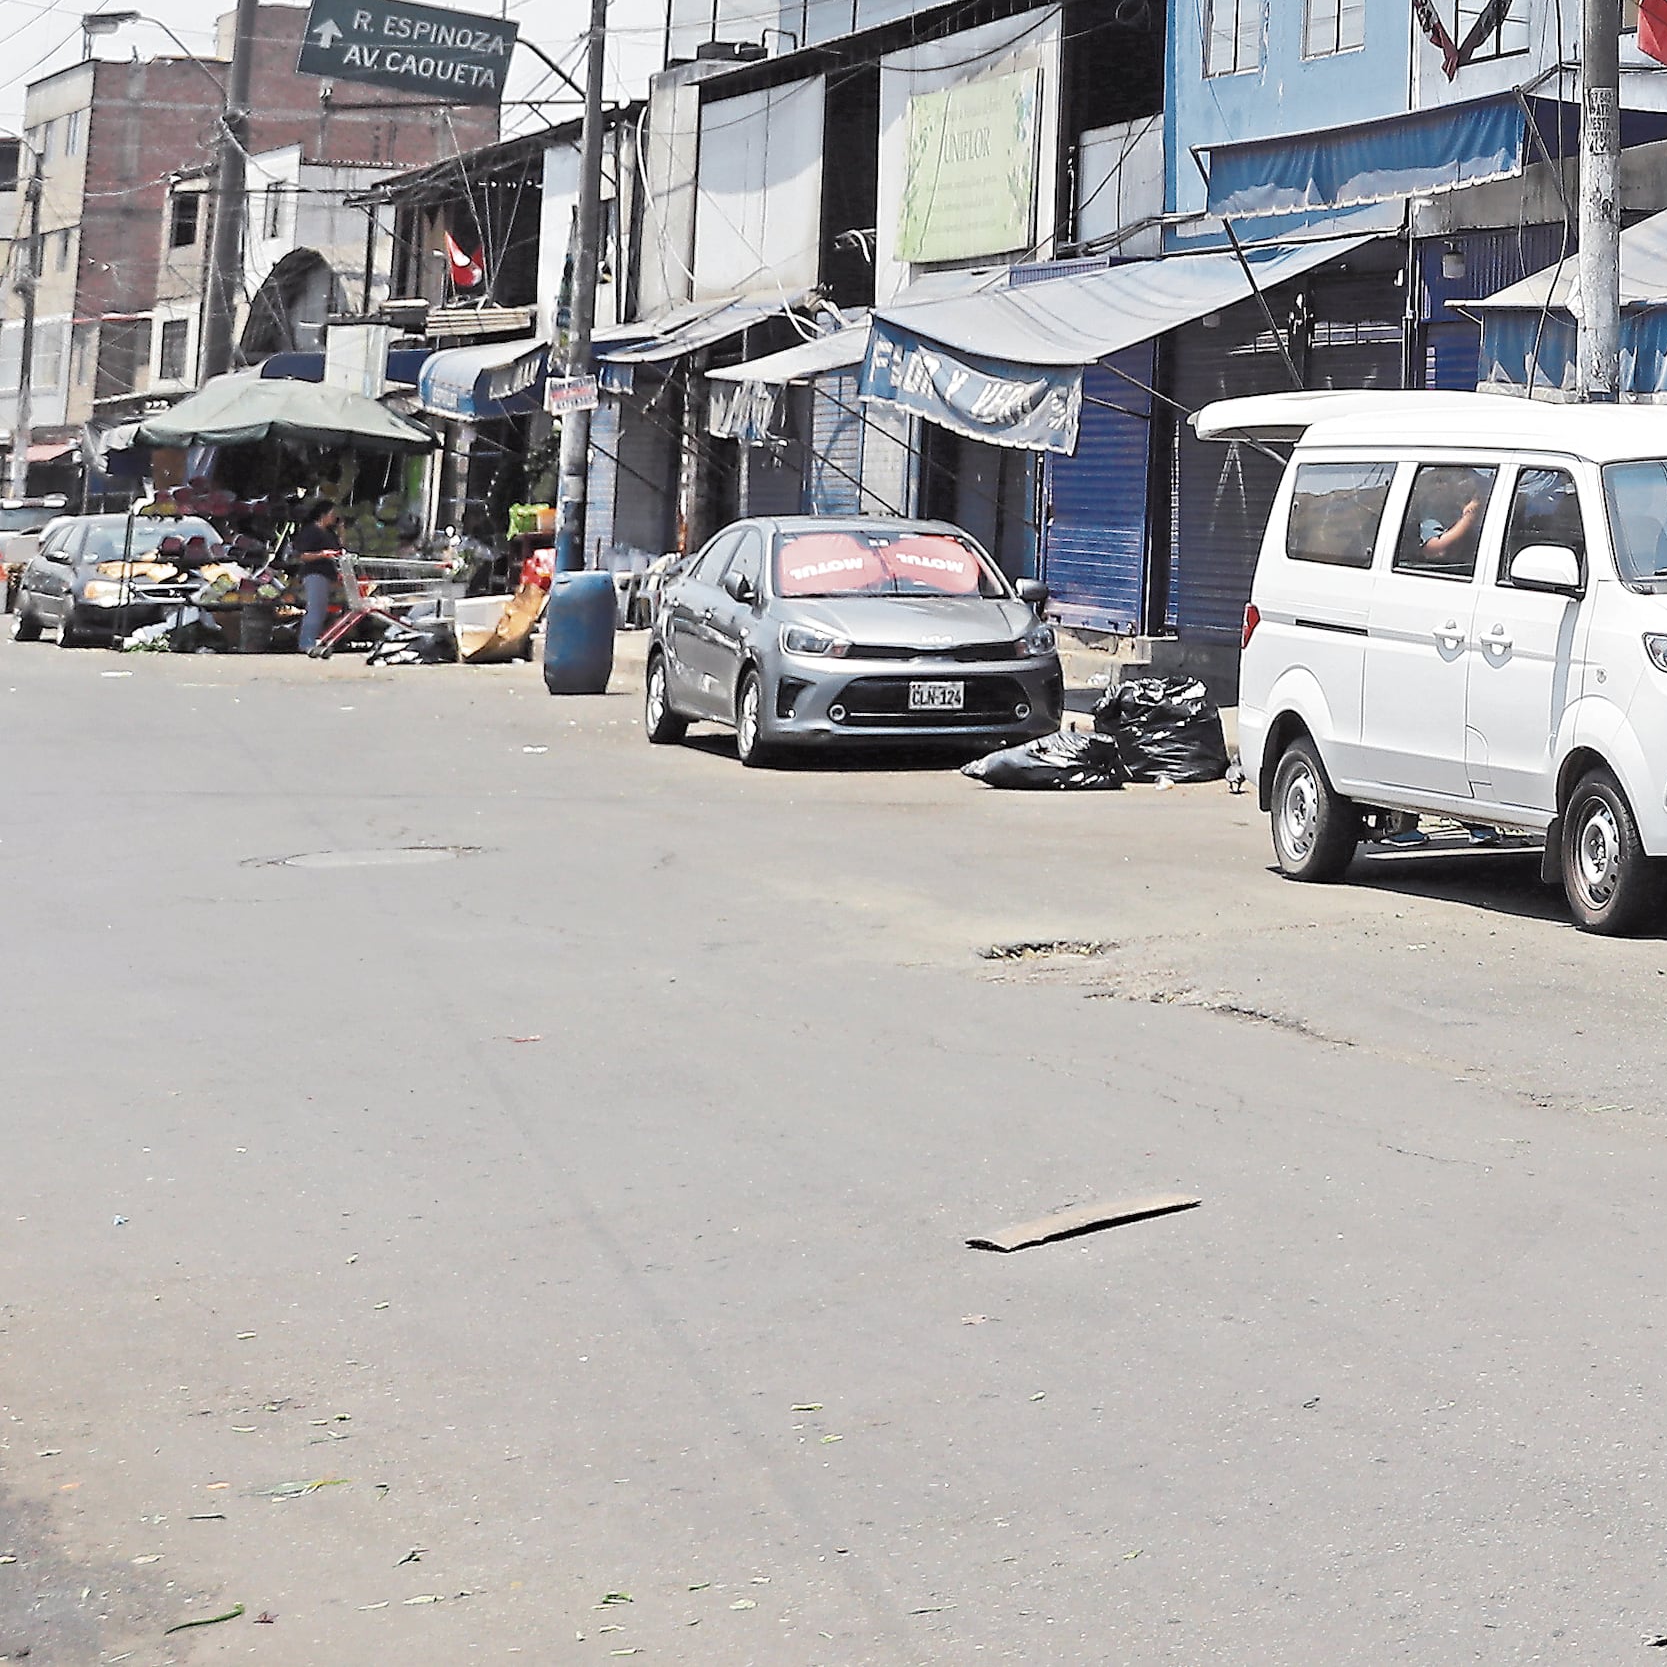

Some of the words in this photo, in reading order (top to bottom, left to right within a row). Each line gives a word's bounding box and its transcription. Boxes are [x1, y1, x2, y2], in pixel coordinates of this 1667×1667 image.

[353, 9, 374, 33] R.
[383, 14, 505, 56] ESPINOZA
[343, 45, 378, 70] AV.
[385, 51, 496, 89] CAQUETA
[943, 127, 991, 164] UNIFLOR
[788, 557, 865, 581] MOTUL
[895, 552, 966, 575] MOTUL
[911, 689, 962, 706] CLN-124
